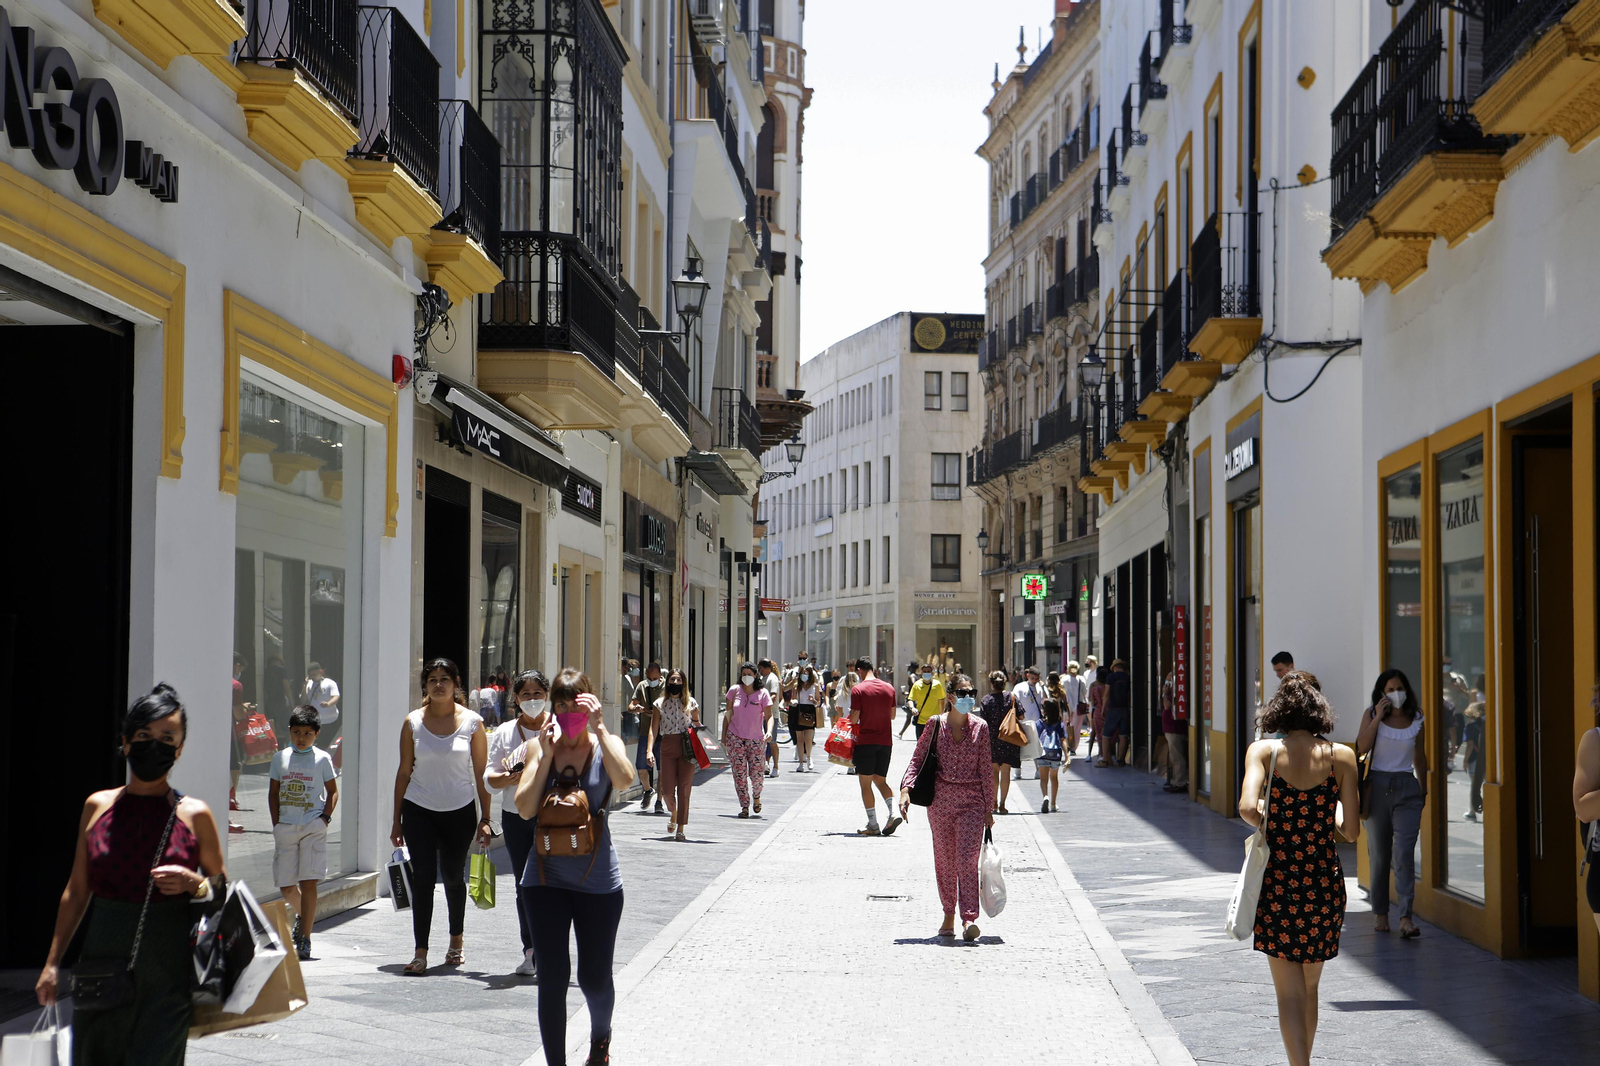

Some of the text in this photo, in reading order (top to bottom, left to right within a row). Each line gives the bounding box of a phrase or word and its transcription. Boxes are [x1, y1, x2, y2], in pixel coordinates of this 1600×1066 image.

[124, 140, 179, 203] MAN
[1446, 494, 1480, 531] ZARA
[1391, 515, 1418, 545] ZARA
[1177, 611, 1184, 630] LA
